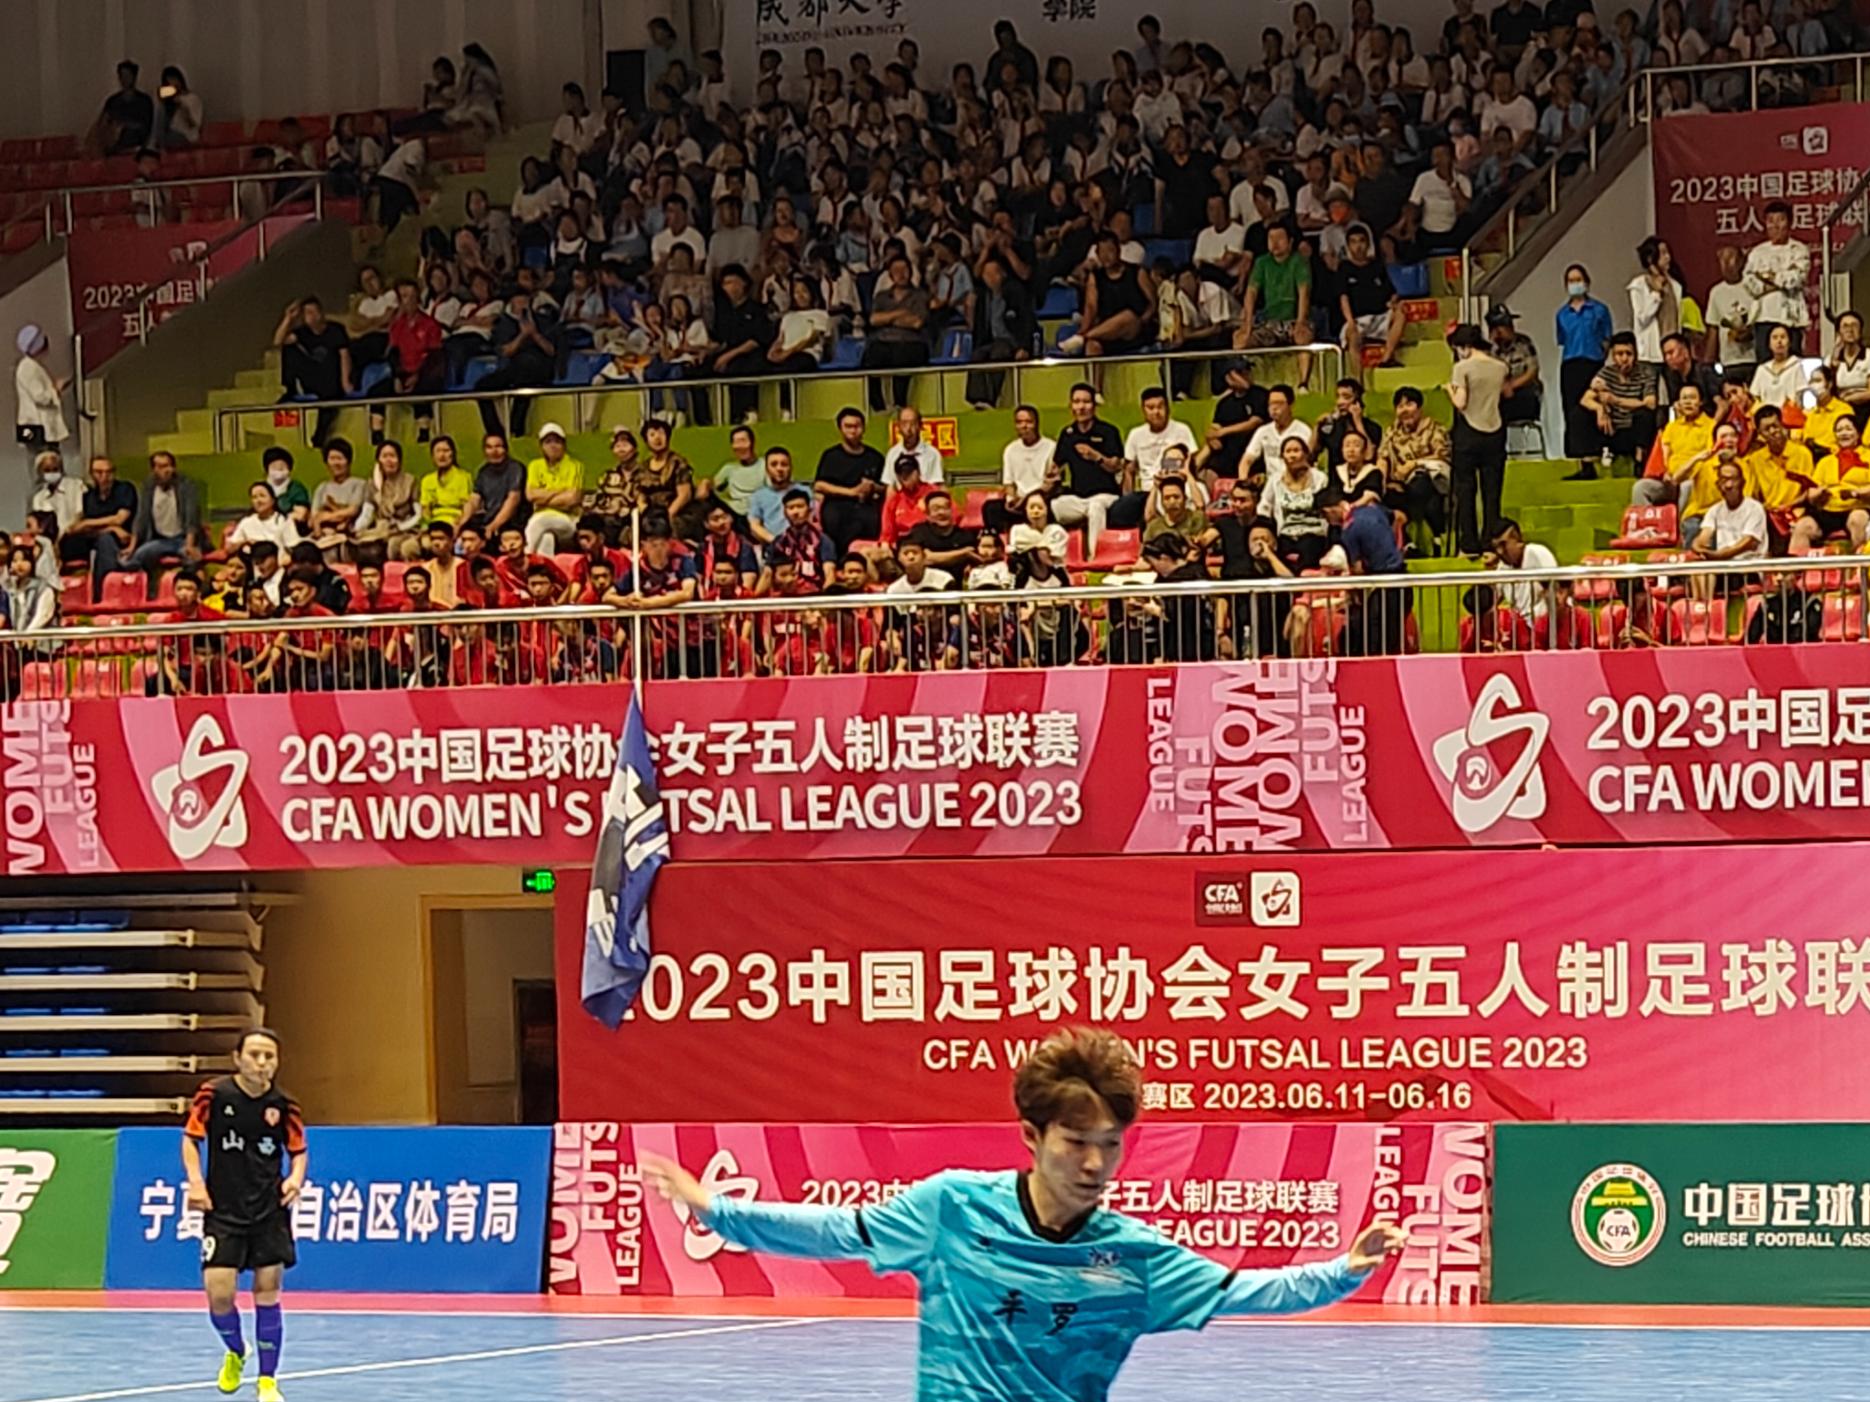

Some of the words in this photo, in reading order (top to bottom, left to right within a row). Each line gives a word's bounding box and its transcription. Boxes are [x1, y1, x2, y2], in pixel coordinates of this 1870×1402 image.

[279, 711, 1081, 785] 2023中国足球协女子五人制足球联赛
[1148, 677, 1174, 812] LEAGUE
[1340, 705, 1368, 842] LEAGUE
[1588, 764, 1685, 813] CFA
[73, 743, 99, 867] LEAGUE
[282, 803, 361, 842] CFA
[362, 792, 592, 839] WOMEN'S
[783, 784, 962, 831] LEAGUE
[969, 780, 1082, 828] 2023
[1205, 884, 1240, 902] CFA
[924, 1039, 996, 1069] CFA
[1190, 1038, 1331, 1069] FUTSAL
[1341, 1038, 1493, 1069] LEAGUE
[1502, 1037, 1588, 1068] 2023
[1204, 1081, 1473, 1110] 2023.06.11-06.16
[616, 1163, 643, 1285] LEAGUE
[1262, 1219, 1340, 1248] 2023
[1606, 1225, 1631, 1237] CFA
[1683, 1231, 1748, 1248] CHINESE
[1755, 1231, 1835, 1248] FOOTBALL
